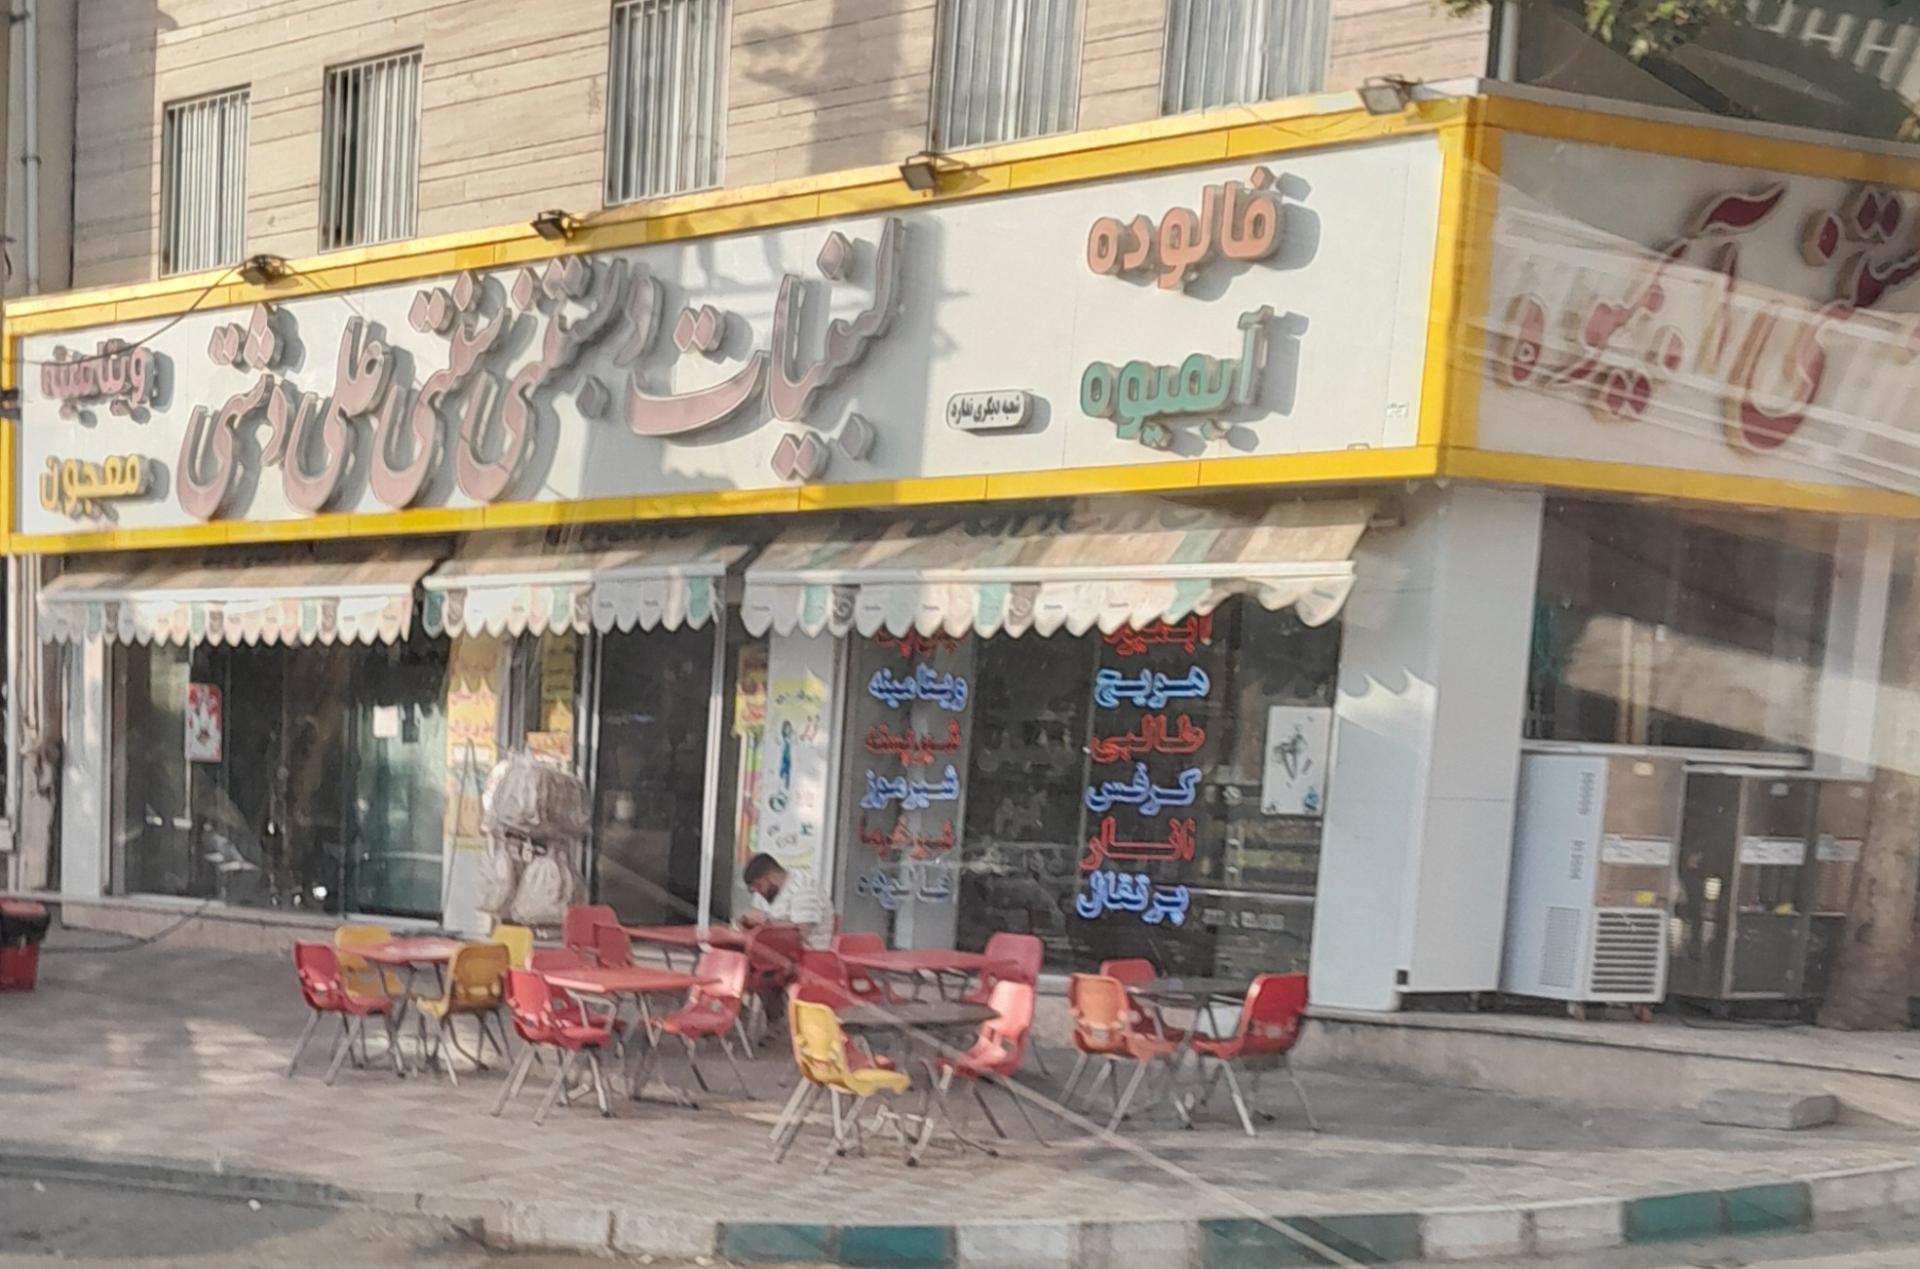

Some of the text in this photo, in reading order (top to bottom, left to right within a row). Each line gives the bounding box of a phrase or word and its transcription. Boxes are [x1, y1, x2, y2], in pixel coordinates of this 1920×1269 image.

[1087, 166, 1281, 290] فالوده
[457, 254, 629, 502] بستنی
[627, 216, 905, 481] لبنیات
[1080, 305, 1274, 449] آبمیوه
[39, 453, 150, 519] معجون
[1096, 665, 1210, 709] هویج
[1089, 714, 1205, 762] طالبی
[1086, 762, 1202, 816] کرفس
[1076, 869, 1190, 927] پرتقال
